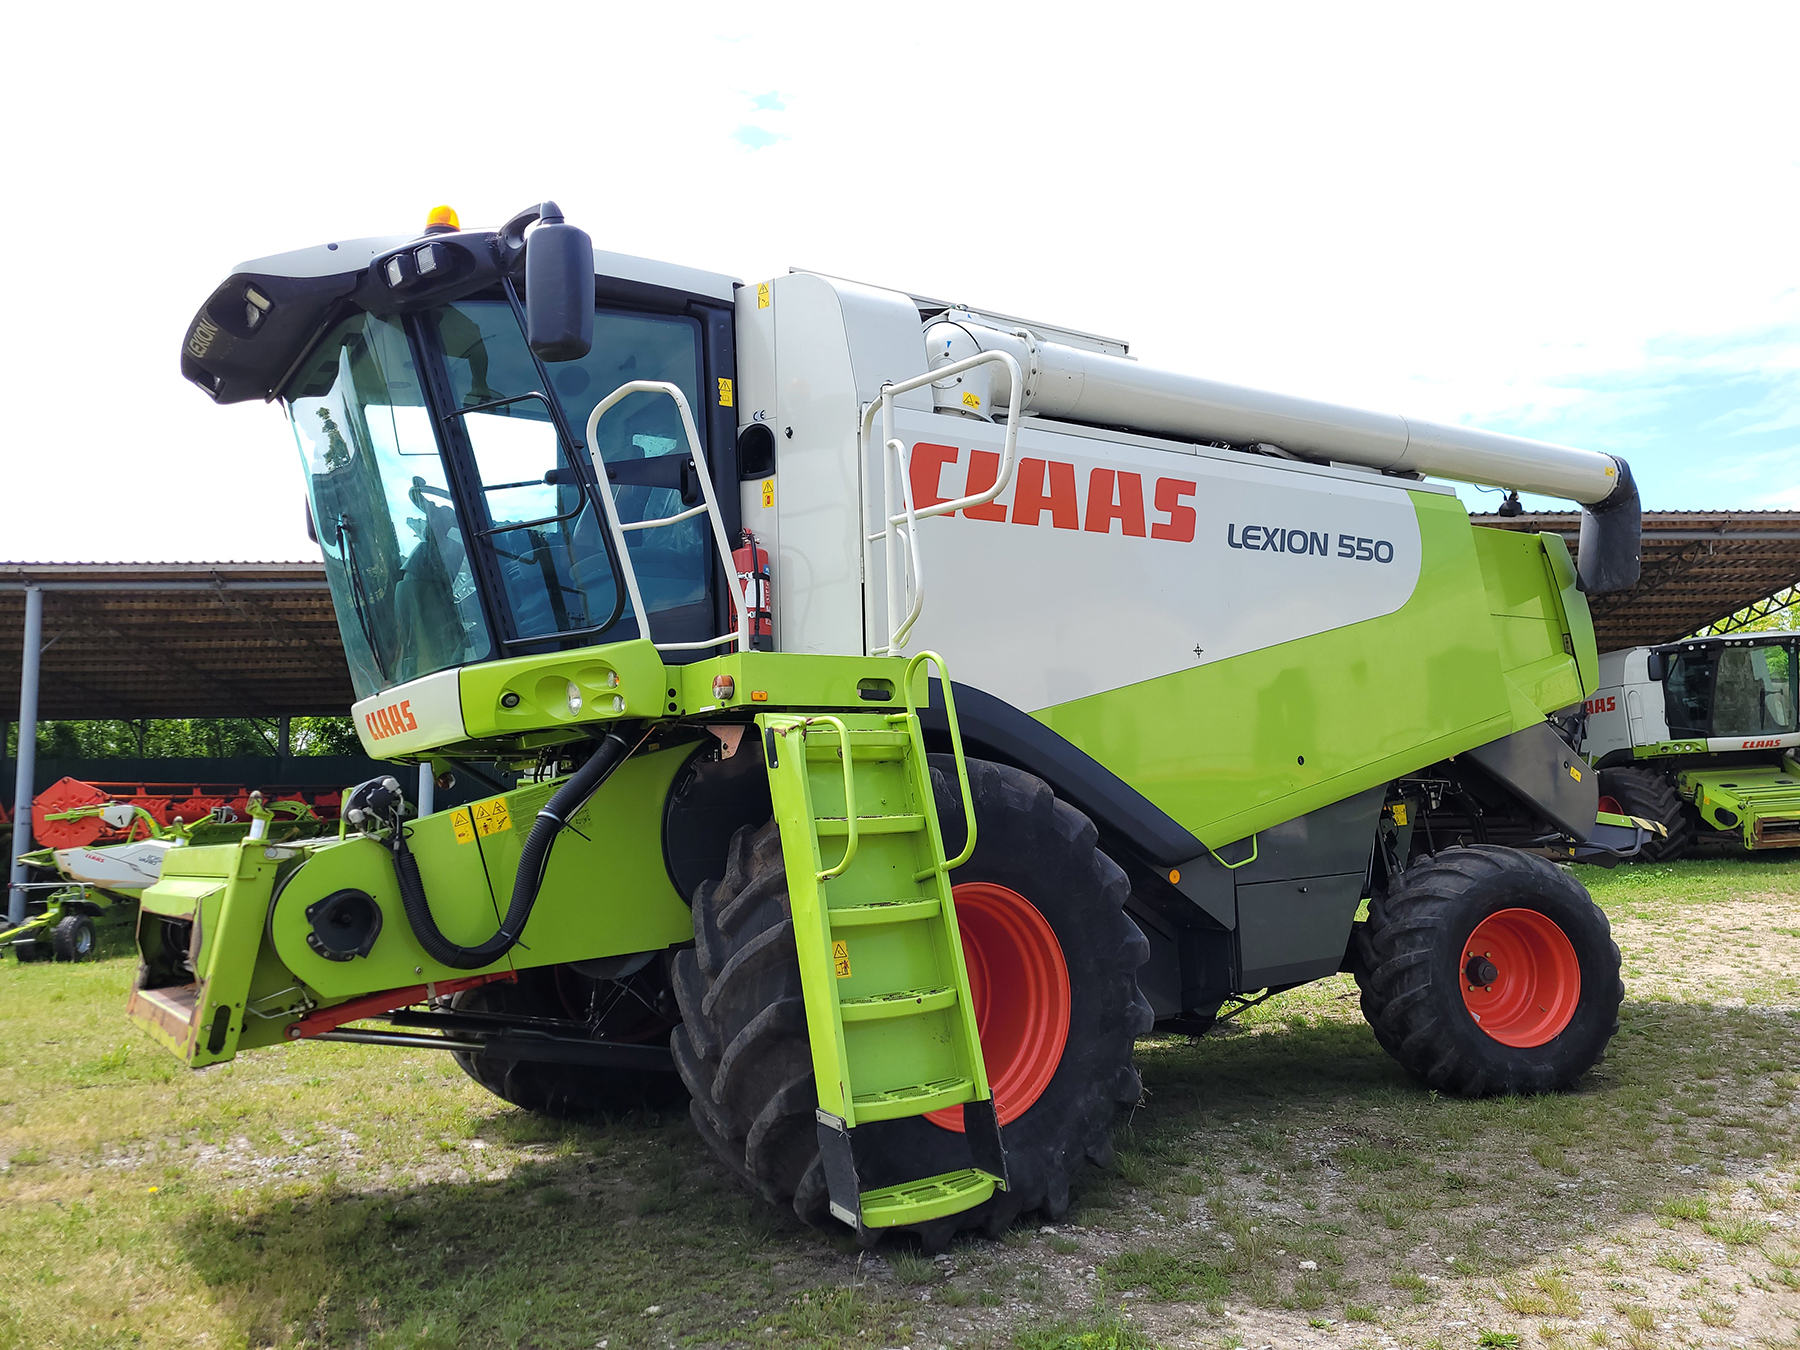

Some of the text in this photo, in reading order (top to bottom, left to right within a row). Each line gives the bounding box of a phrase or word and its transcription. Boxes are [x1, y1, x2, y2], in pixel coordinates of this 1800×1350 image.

[187, 317, 218, 358] LEXION
[904, 442, 1197, 543] CLAAS
[1227, 523, 1394, 563] LEXION 550
[365, 699, 418, 741] CLAAS
[1584, 696, 1616, 714] AAS
[1741, 739, 1781, 749] CLAAS
[117, 814, 124, 825] 1
